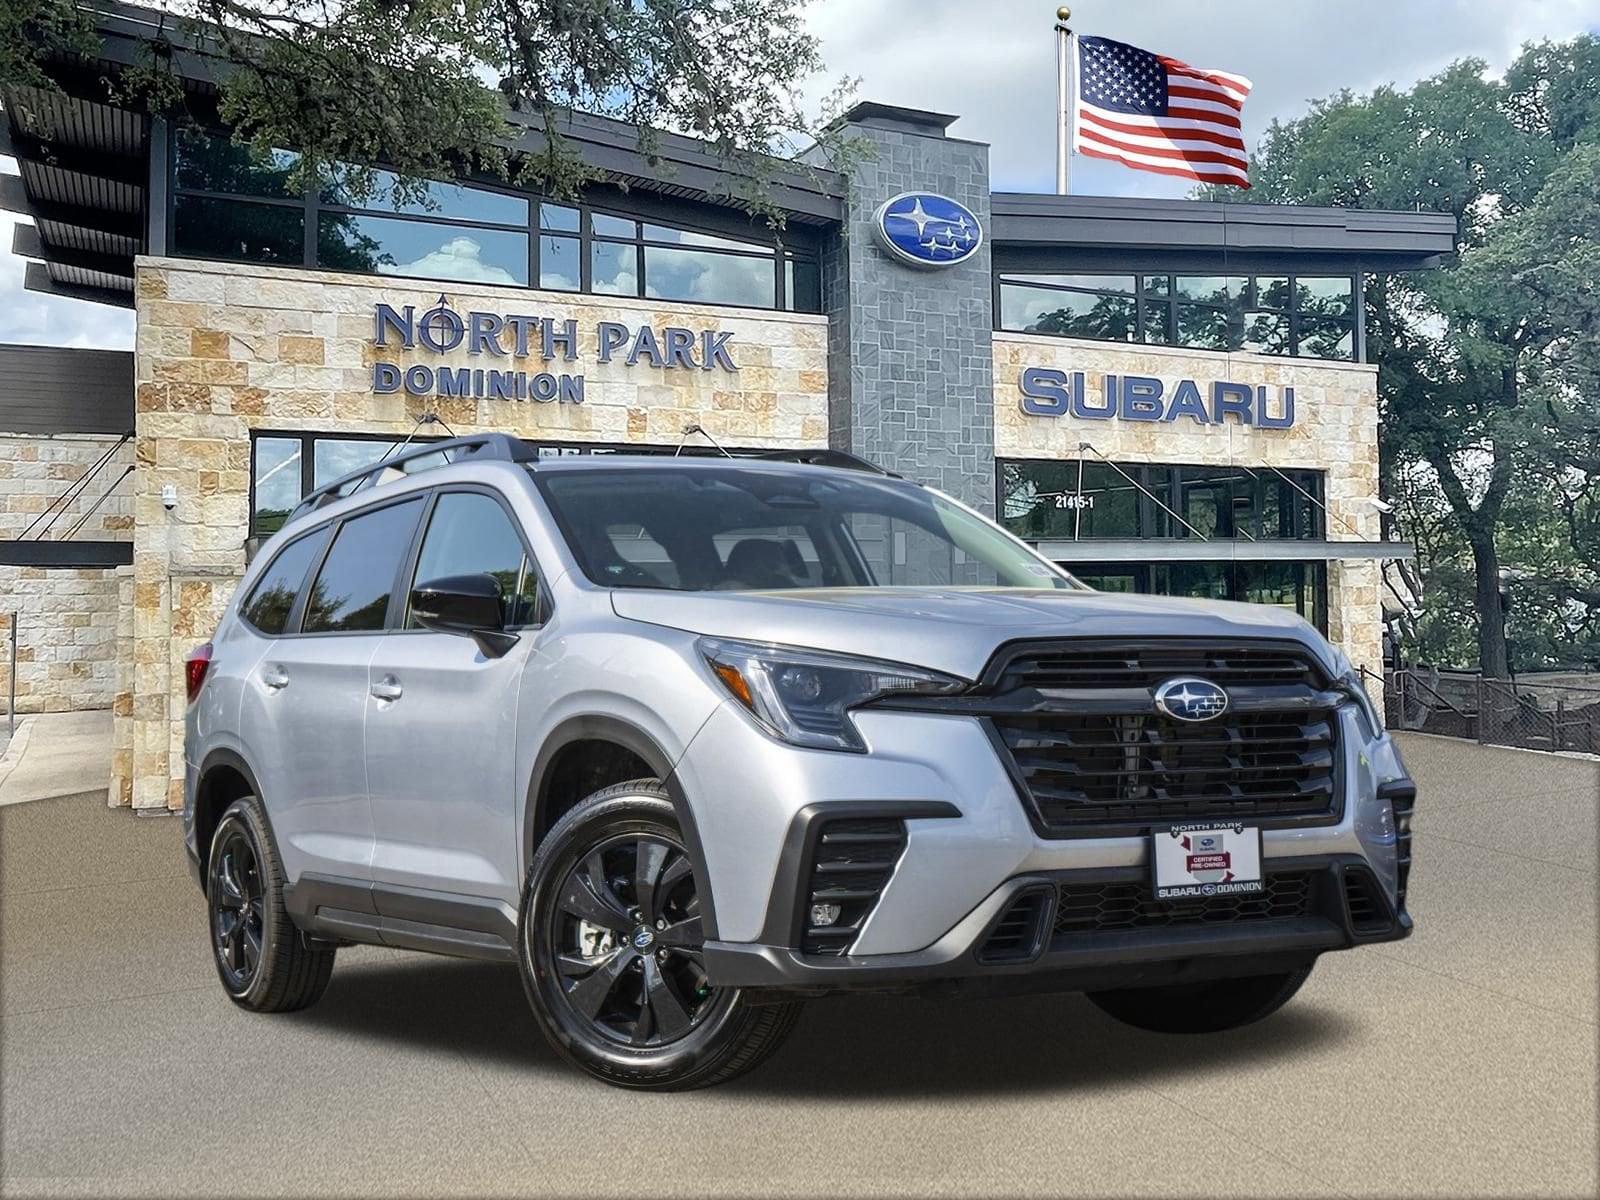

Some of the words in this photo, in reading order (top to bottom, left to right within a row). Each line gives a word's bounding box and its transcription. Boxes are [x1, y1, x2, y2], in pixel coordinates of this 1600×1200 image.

[374, 302, 580, 362] NORTH
[598, 321, 741, 373] PARK
[373, 362, 585, 404] DOMINION
[1019, 367, 1295, 430] SUBARU
[1055, 495, 1094, 509] 21415-1
[1171, 823, 1210, 832] NORTH
[1213, 822, 1243, 830] PARK
[1158, 886, 1201, 898] SUBARU
[1216, 882, 1262, 893] DOMINION
